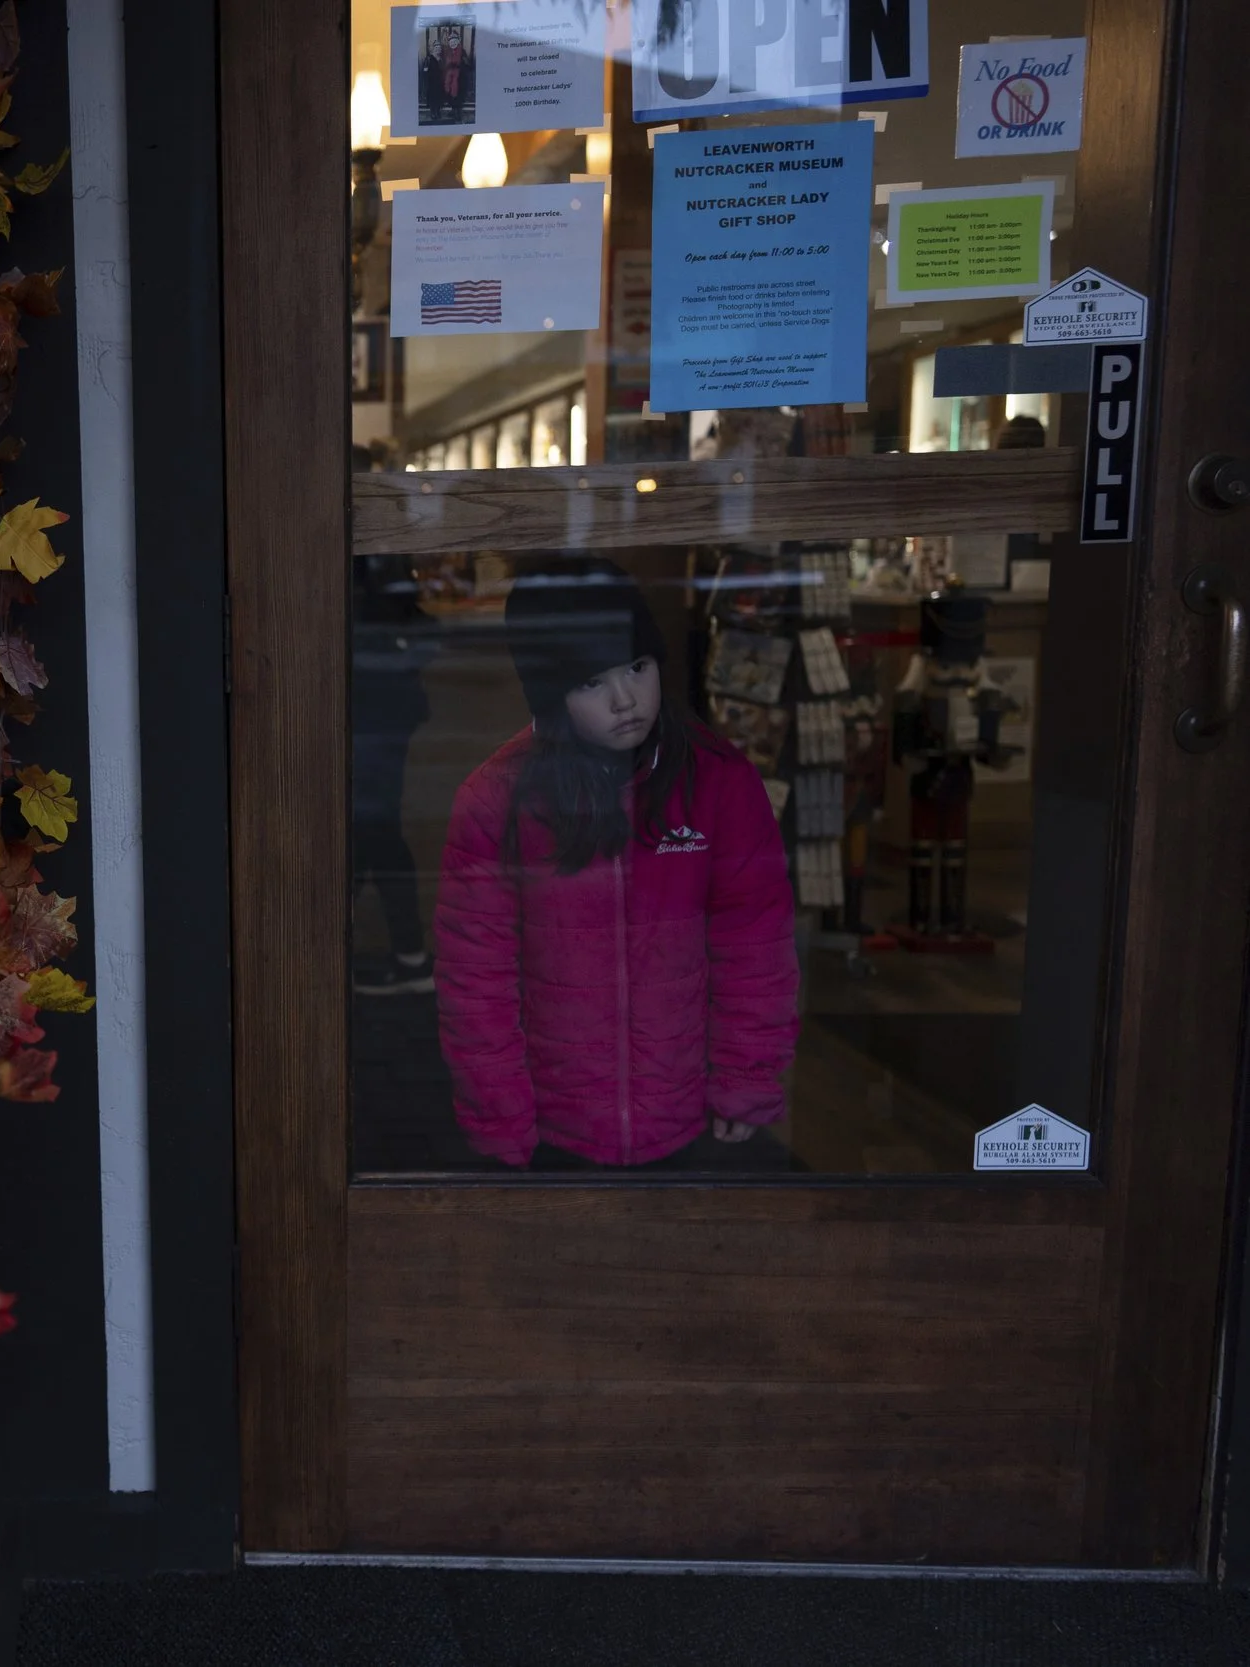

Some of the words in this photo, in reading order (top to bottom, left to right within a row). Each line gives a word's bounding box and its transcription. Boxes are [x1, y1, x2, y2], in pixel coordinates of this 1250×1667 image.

[657, 0, 910, 99] OPEN
[517, 55, 528, 63] will
[538, 53, 560, 61] closed
[528, 68, 558, 77] celebrate
[974, 59, 1010, 81] No
[1017, 54, 1073, 79] Food
[516, 84, 551, 92] Nutcracker
[533, 98, 561, 107] Birthday.
[977, 125, 1002, 140] OR
[1006, 121, 1065, 139] DRINK
[703, 140, 815, 157] LEAVENWORTH
[674, 161, 775, 178] NUTCRACKER
[779, 157, 844, 172] MUSEUM
[749, 180, 768, 189] and
[686, 195, 787, 211] NUTCRACKER
[791, 192, 829, 205] LADY
[416, 215, 439, 223] Thank
[440, 215, 456, 224] you,
[457, 213, 491, 222] Veterans,
[492, 212, 504, 220] for
[516, 212, 533, 221] your
[534, 210, 563, 218] service.
[718, 216, 752, 228] GIFT
[757, 213, 796, 226] SHOP
[918, 225, 957, 233] Thanksgiving
[916, 237, 948, 245] Christmas
[685, 252, 706, 264] Open
[709, 251, 728, 261] each
[730, 250, 747, 261] day
[748, 249, 768, 261] from
[771, 247, 795, 257] 11:00
[796, 247, 805, 257] to
[806, 245, 830, 255] 5:00
[916, 248, 947, 256] Christmas
[697, 285, 719, 293] Public
[720, 283, 755, 292] restrooms
[770, 281, 793, 289] across
[795, 279, 816, 288] street
[681, 295, 706, 304] Please
[708, 294, 727, 302] finish
[728, 293, 744, 301] food
[754, 291, 776, 299] drinks
[777, 290, 800, 298] before
[802, 288, 830, 298] entering
[717, 302, 762, 312] Photography
[771, 299, 794, 308] limited
[678, 314, 707, 323] Children
[722, 311, 754, 320] welcome
[763, 310, 776, 318] this
[1034, 314, 1082, 325] KEYHOLE
[1085, 311, 1138, 323] SECURITY
[681, 324, 699, 333] Dogs
[701, 323, 718, 331] must
[720, 322, 729, 330] be
[759, 320, 782, 328] unless
[784, 318, 809, 327] Service
[811, 317, 831, 326] Dogs
[1066, 321, 1137, 329] SURVEILLANCE
[1058, 328, 1112, 338] 509-663-5610
[682, 357, 711, 367] Proceeds
[712, 357, 728, 367] from
[730, 355, 744, 366] Gift
[745, 354, 763, 364] Shop
[765, 354, 776, 362] are
[778, 353, 793, 361] used
[794, 353, 801, 361] to
[802, 351, 828, 362] support
[694, 370, 707, 379] The
[771, 378, 810, 389] Corporation
[1094, 355, 1132, 530] PULL
[983, 1142, 1029, 1151] KEYHOLE
[1031, 1142, 1081, 1151] SECURITY
